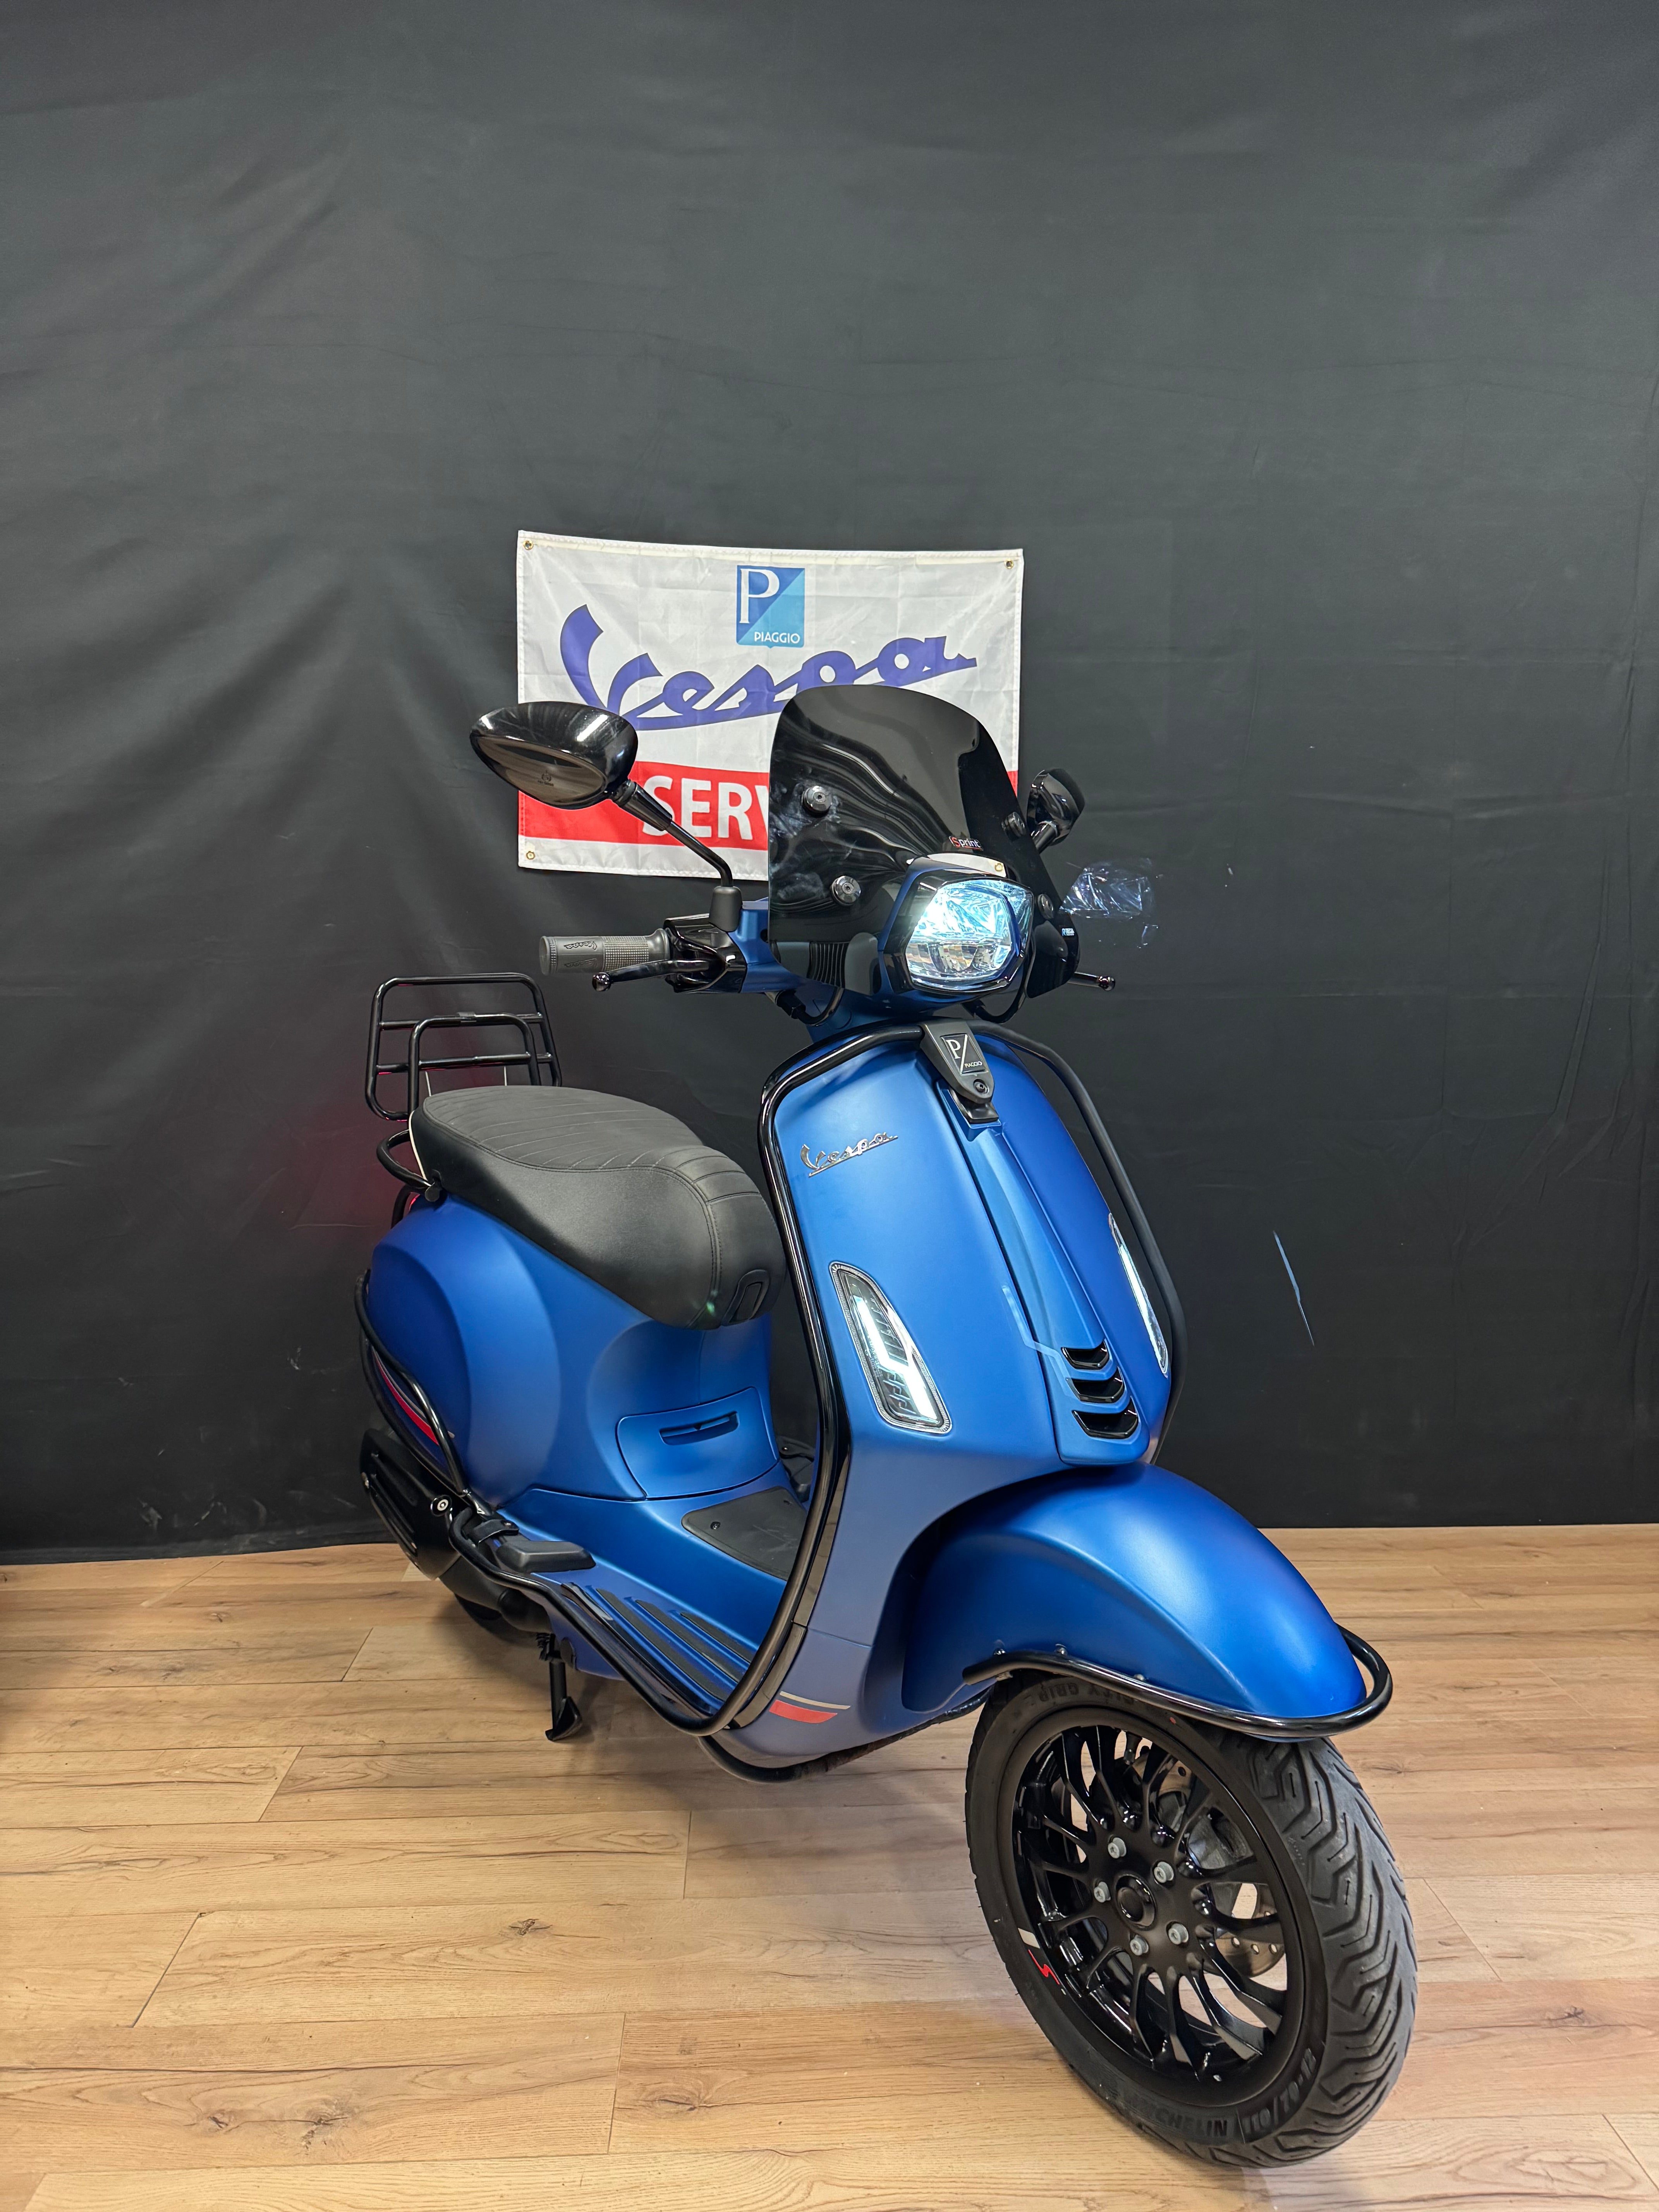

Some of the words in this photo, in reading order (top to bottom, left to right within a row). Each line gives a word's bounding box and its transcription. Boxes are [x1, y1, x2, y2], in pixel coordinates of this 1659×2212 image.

[739, 568, 780, 623] P
[754, 632, 800, 644] PIAGGIO
[560, 604, 977, 731] Vespa
[951, 836, 981, 848] Sprint
[945, 1039, 961, 1059] P
[800, 1132, 898, 1178] Vespa
[1127, 2092, 1228, 2136] CHELIN
